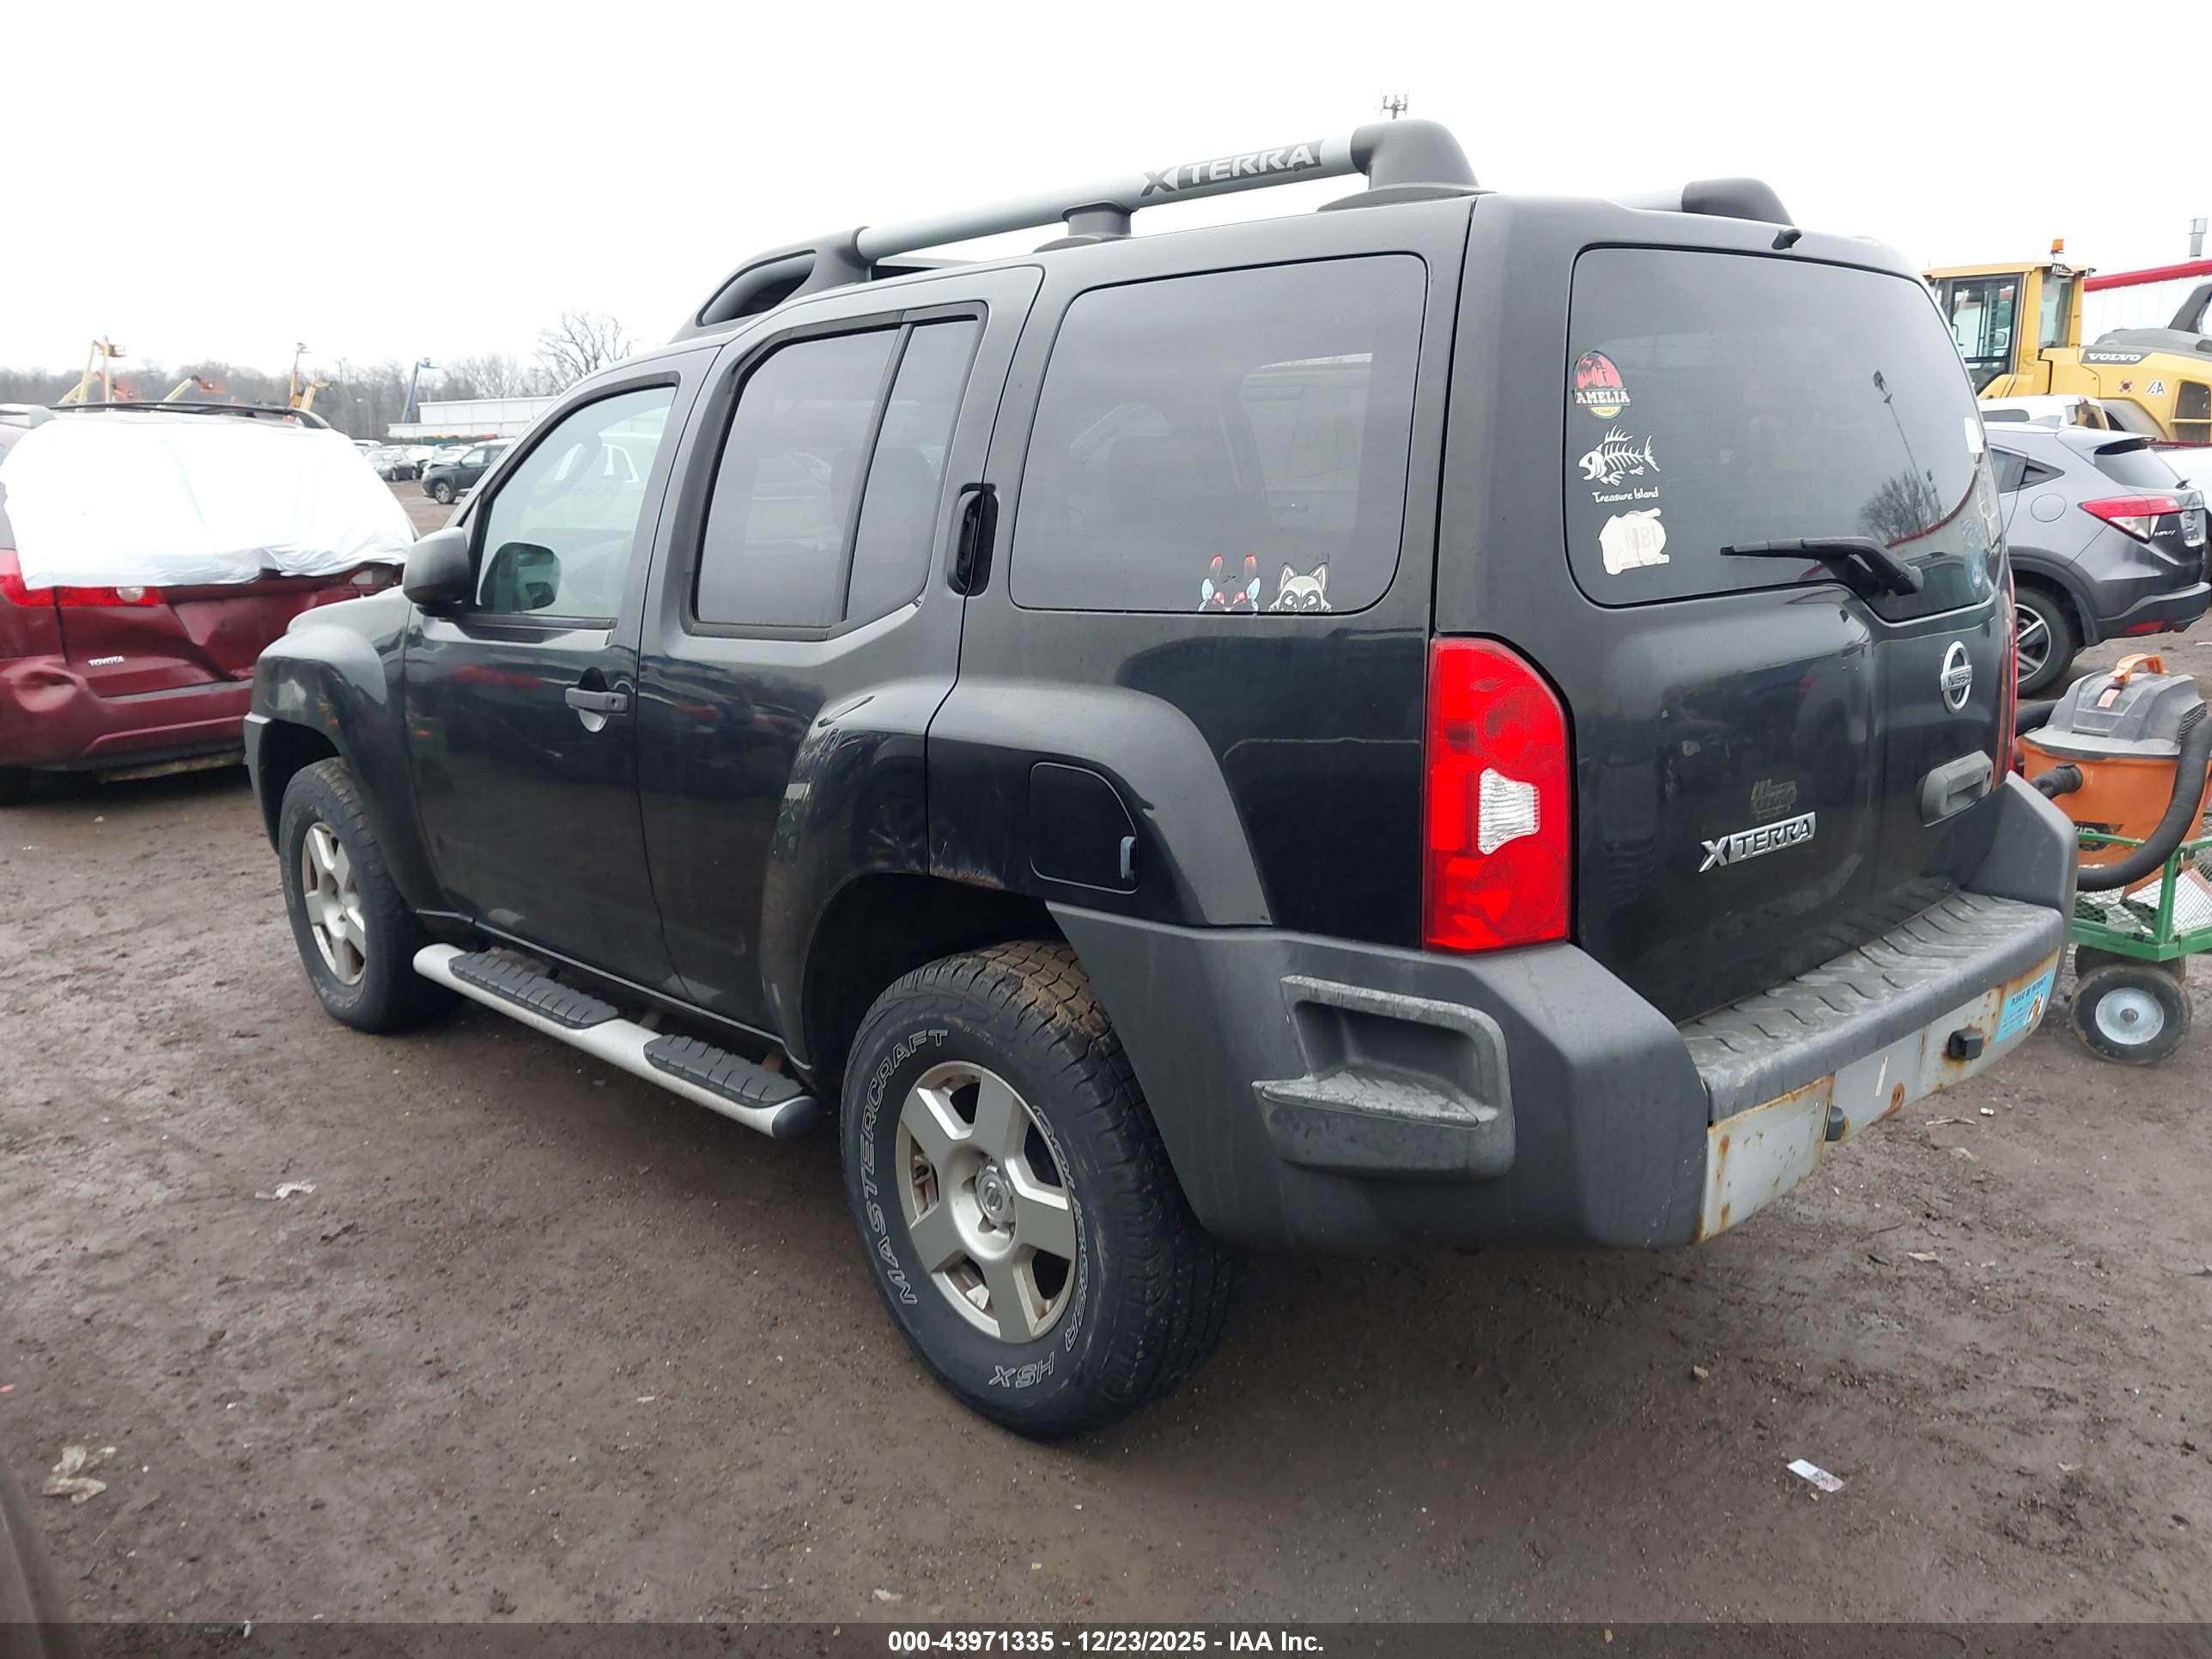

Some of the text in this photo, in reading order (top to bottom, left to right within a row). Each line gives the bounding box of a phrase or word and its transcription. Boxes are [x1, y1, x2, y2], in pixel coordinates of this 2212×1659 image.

[1140, 143, 1315, 196] XTERRA
[1576, 391, 1631, 404] AMELIA
[1592, 487, 1658, 502] Treasure Island
[88, 655, 125, 666] TOYOTA
[1699, 811, 1815, 872] XTERRA
[860, 1030, 948, 1305] MASTERCRAFT
[988, 1351, 1054, 1389] HSX
